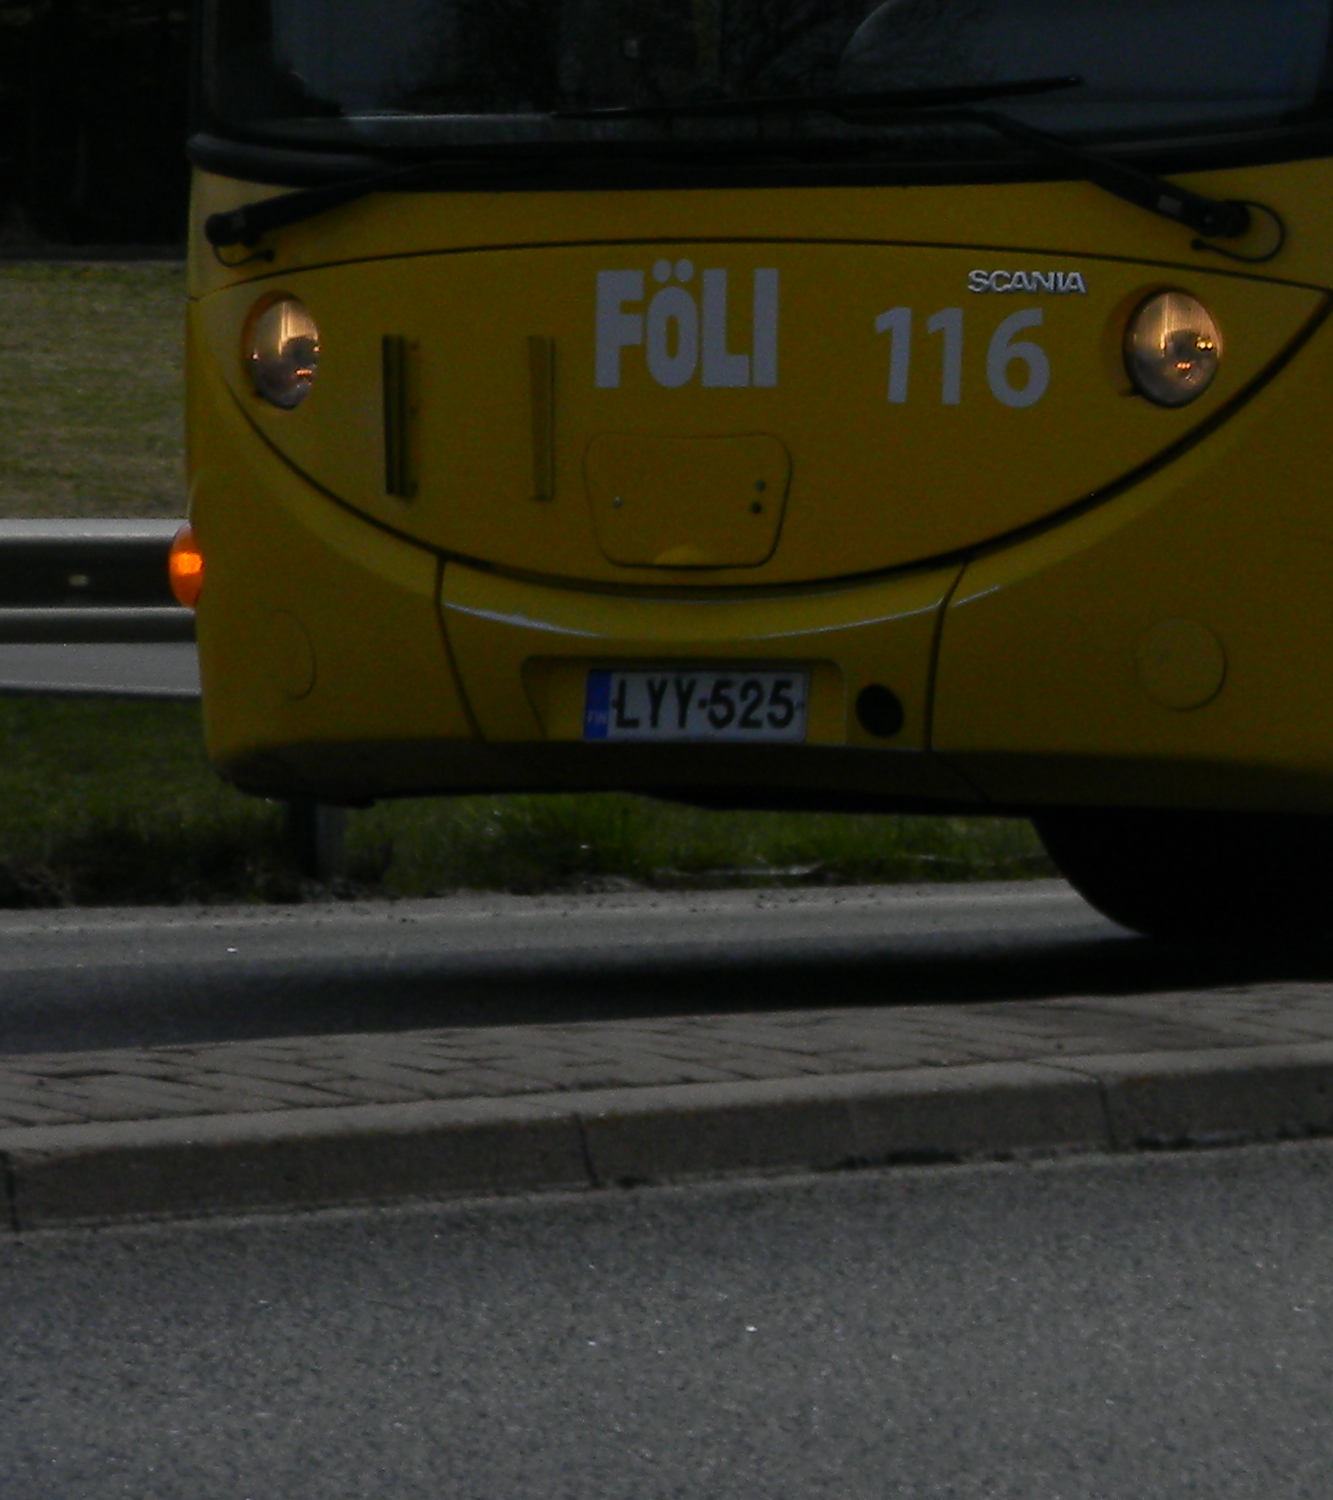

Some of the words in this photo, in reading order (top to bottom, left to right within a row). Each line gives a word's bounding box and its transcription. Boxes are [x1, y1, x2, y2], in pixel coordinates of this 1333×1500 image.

[967, 269, 1088, 295] SCANIA
[593, 258, 781, 390] FÖLI
[873, 306, 1052, 410] 116
[614, 678, 796, 730] LYY-525
